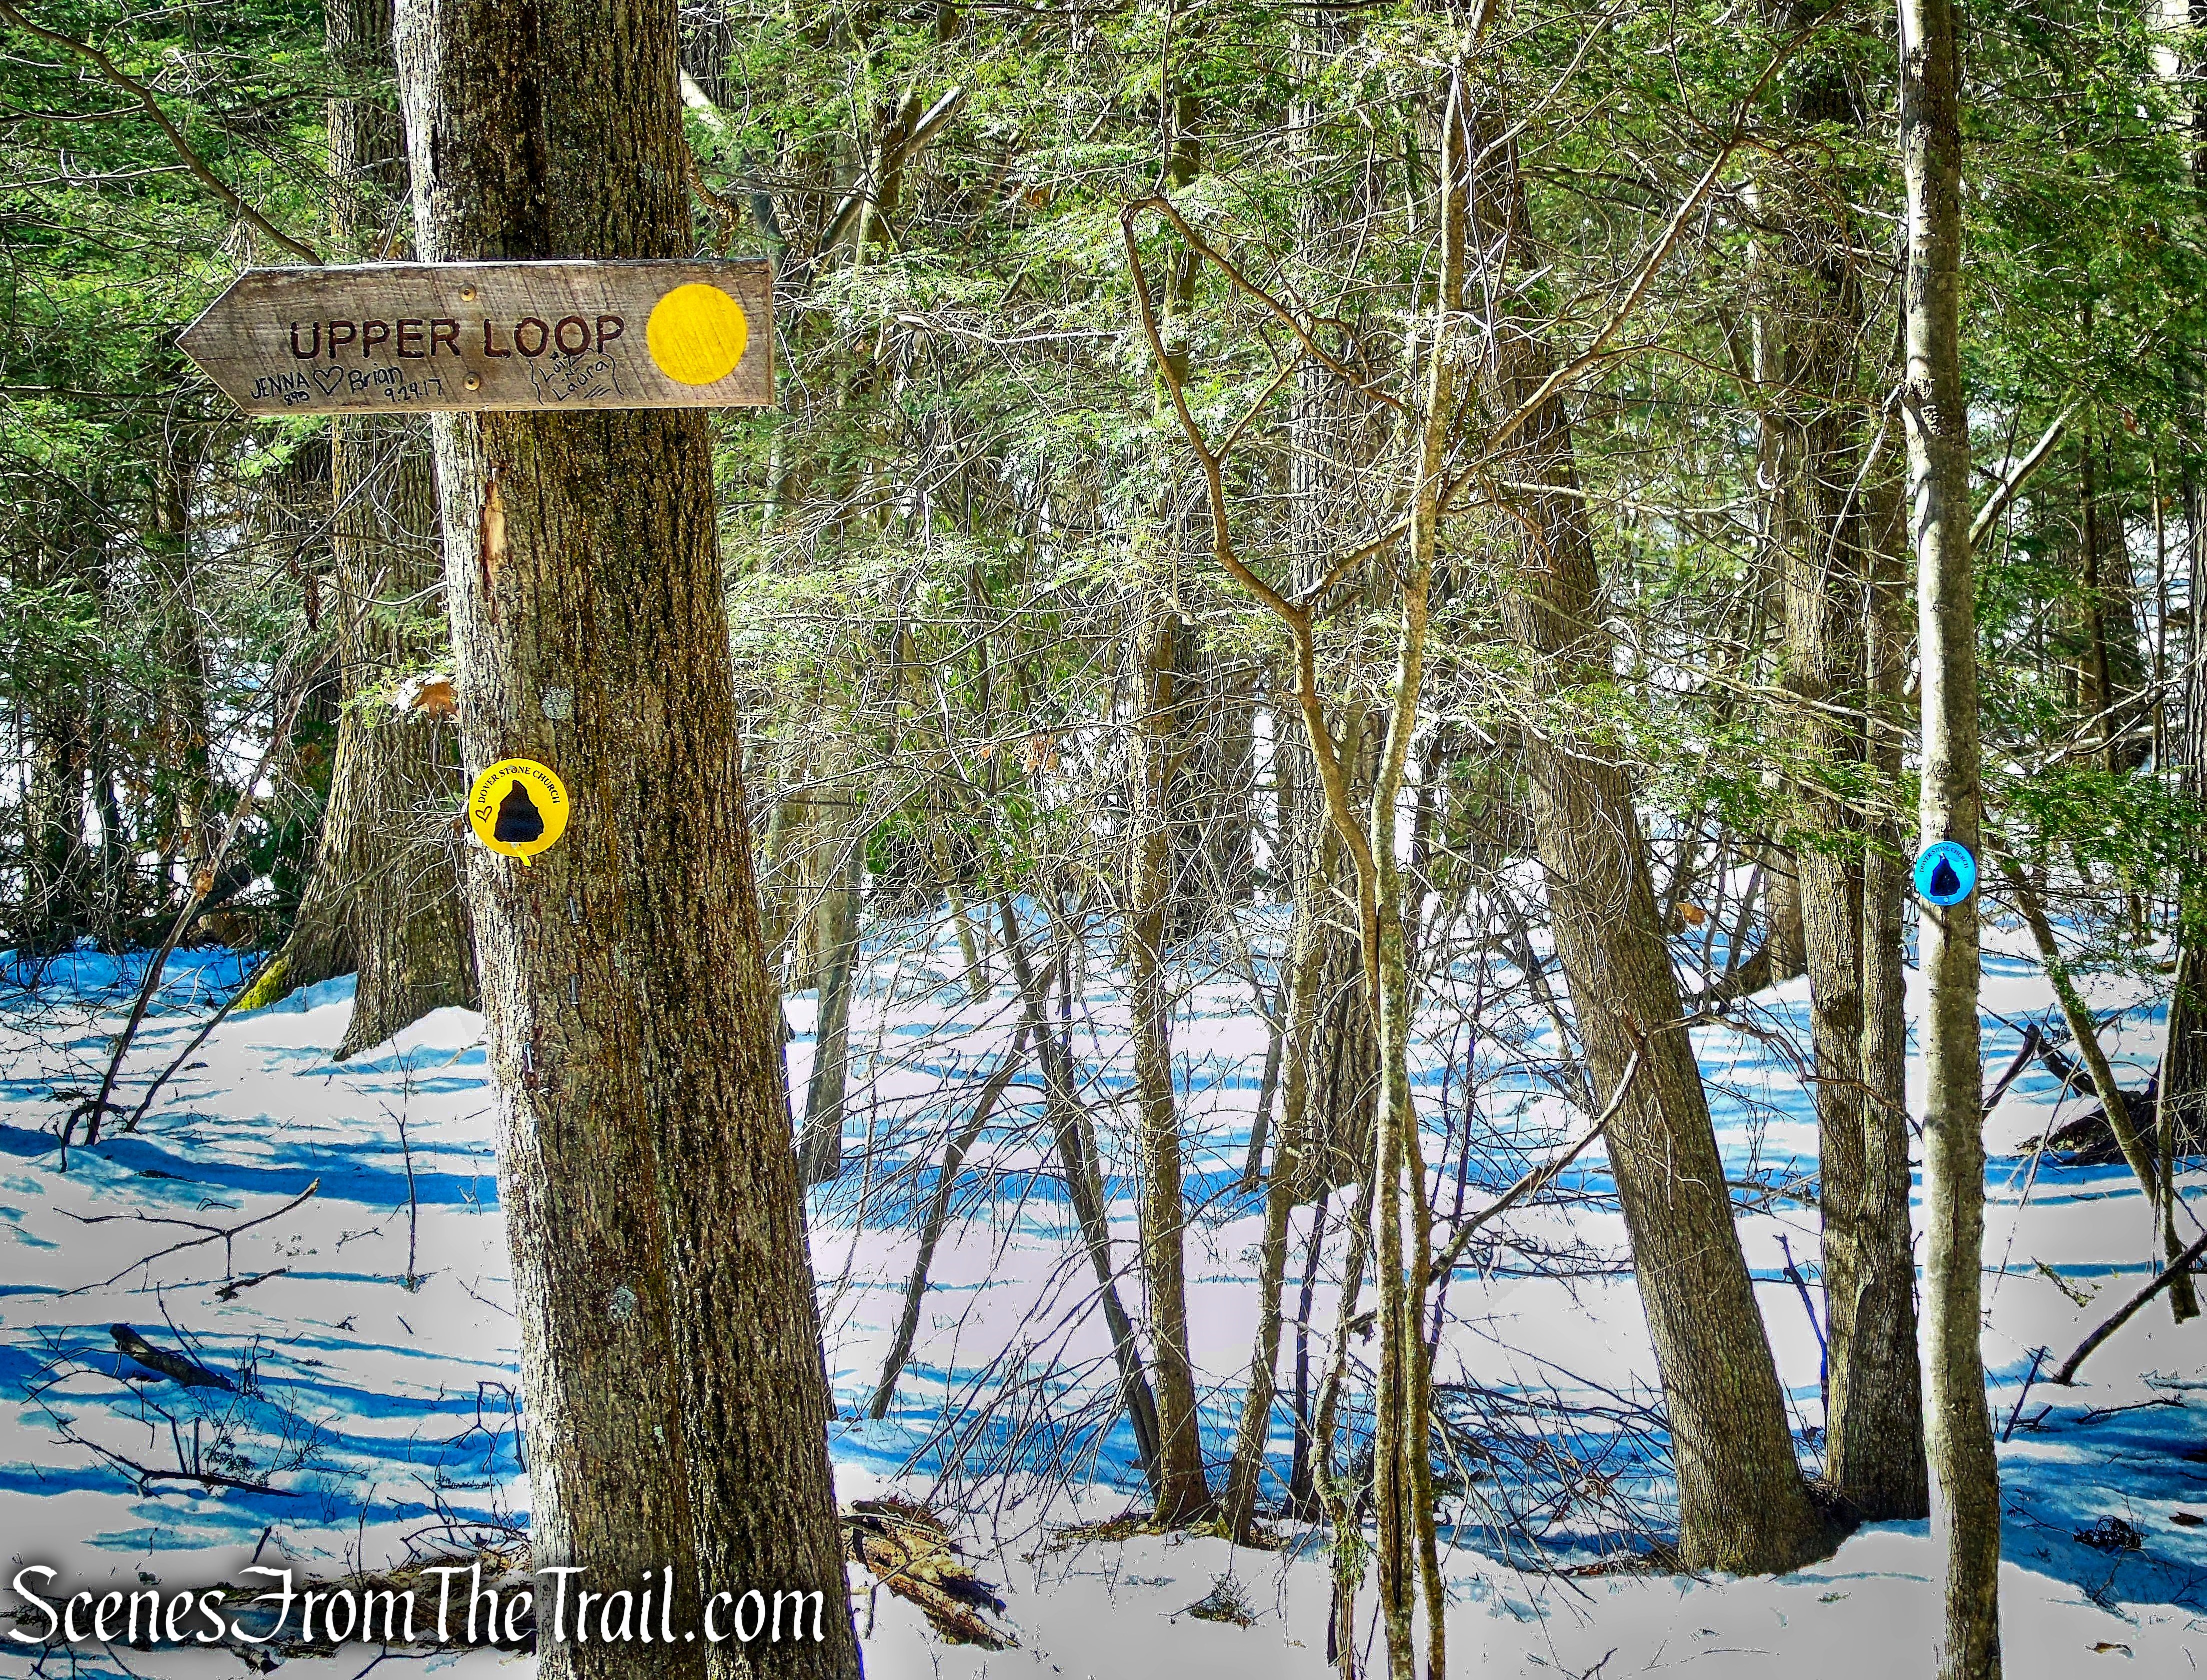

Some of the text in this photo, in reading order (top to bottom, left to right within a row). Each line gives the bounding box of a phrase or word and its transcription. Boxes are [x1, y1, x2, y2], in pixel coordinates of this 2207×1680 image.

[290, 315, 625, 360] UPPER LOOP
[251, 362, 404, 400] JENNA Brian
[384, 378, 442, 403] 9.24.17
[551, 360, 609, 401] Laura
[478, 766, 560, 804] DOVER STONE CHURCH
[1920, 853, 1932, 872] DOVER
[1951, 848, 1969, 868] CHURCH
